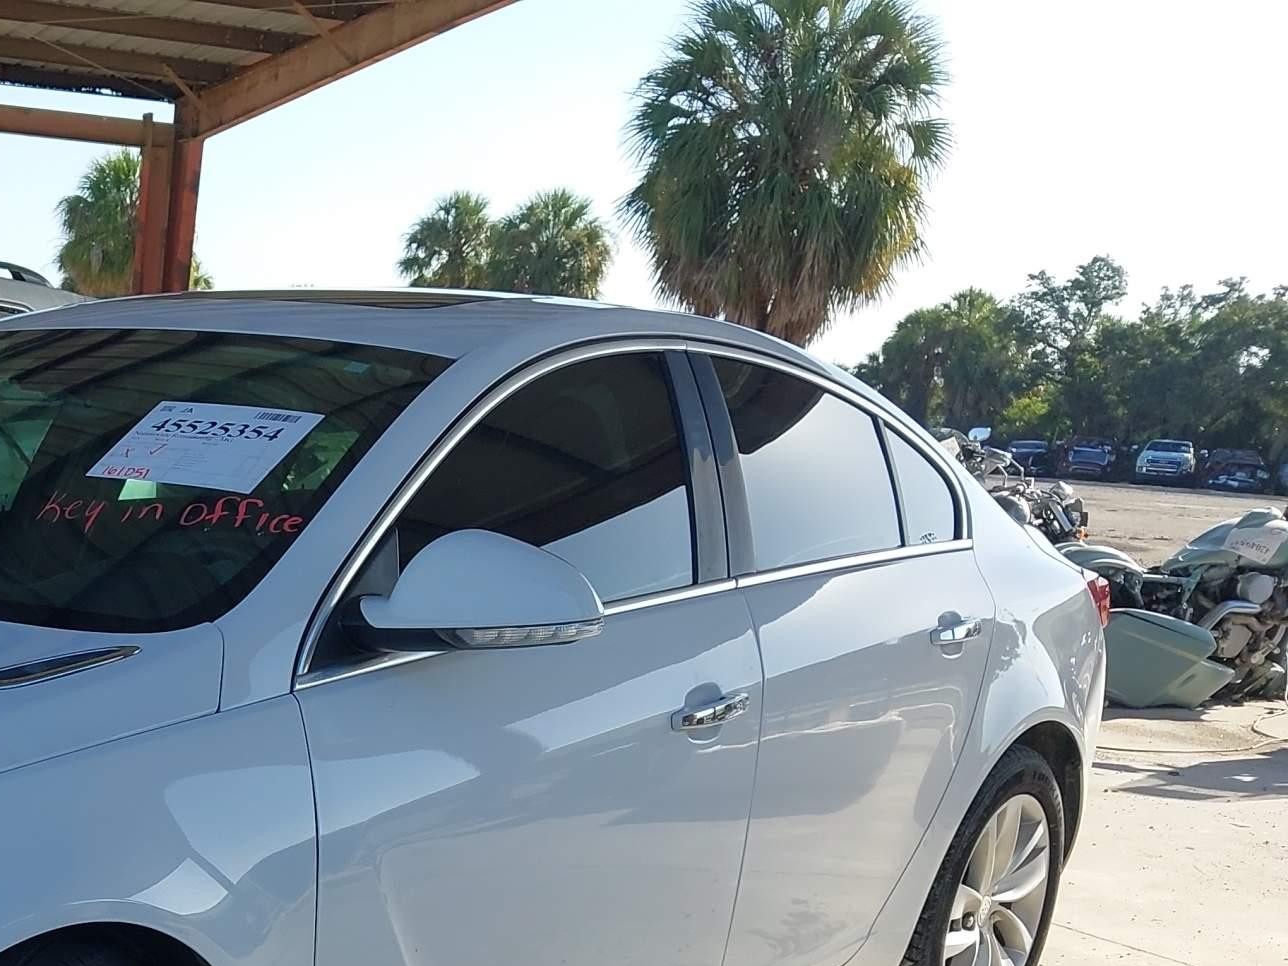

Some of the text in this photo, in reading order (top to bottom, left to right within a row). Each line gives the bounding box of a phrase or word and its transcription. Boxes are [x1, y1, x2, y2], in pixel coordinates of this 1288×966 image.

[151, 417, 284, 441] 45525354
[37, 492, 106, 532] Key
[121, 503, 163, 522] in
